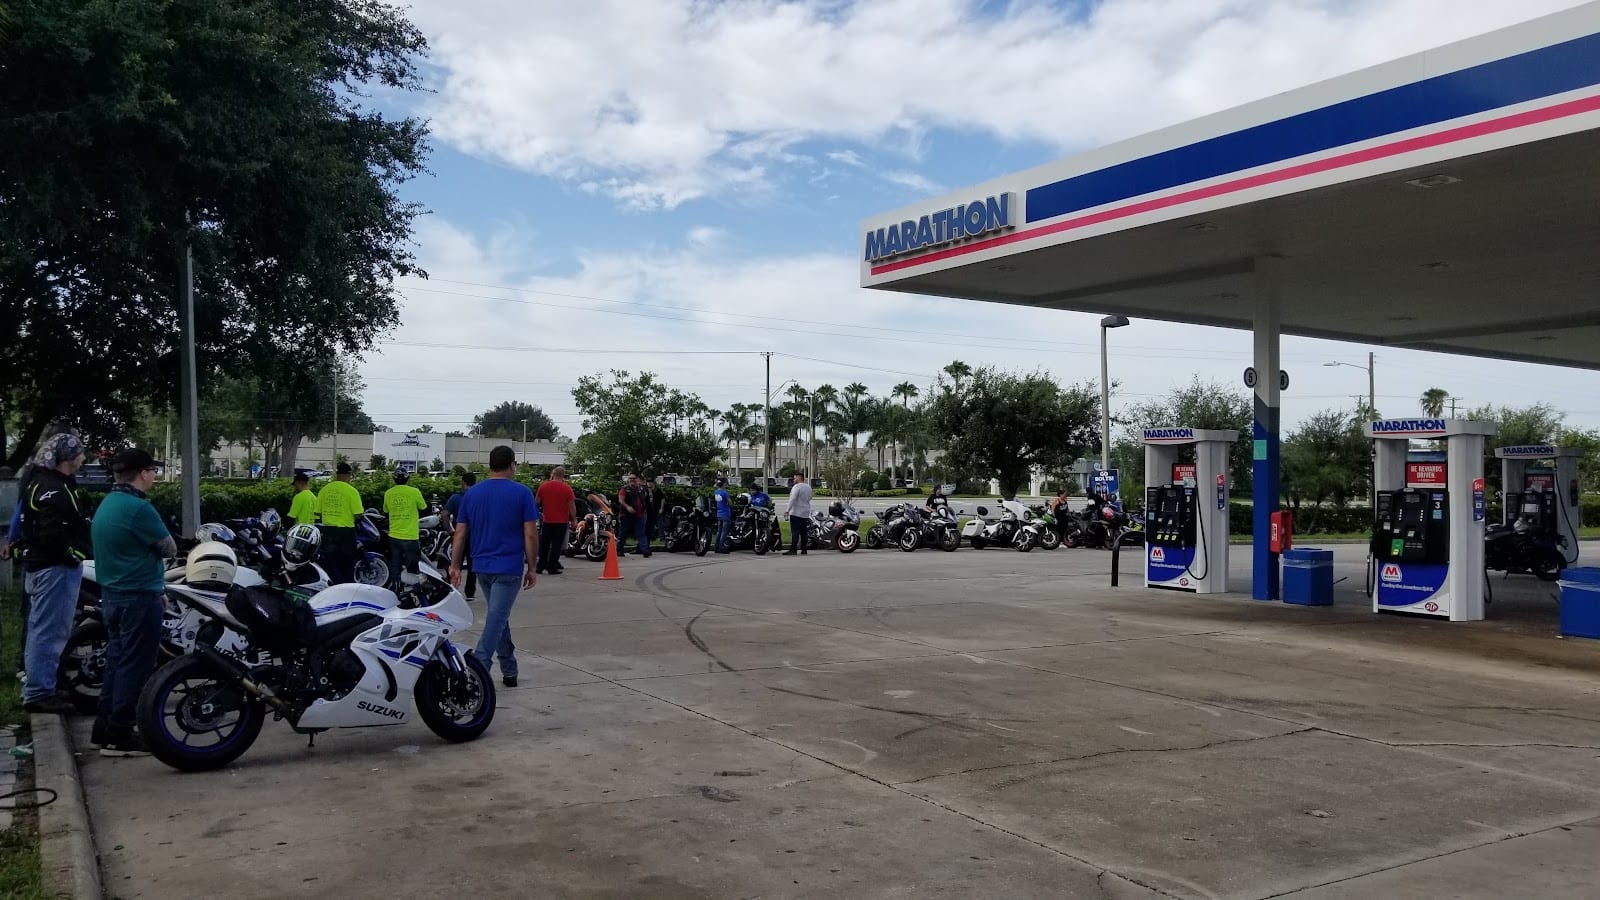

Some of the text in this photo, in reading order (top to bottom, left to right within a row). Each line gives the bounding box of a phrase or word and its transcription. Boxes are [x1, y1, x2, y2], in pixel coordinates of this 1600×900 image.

[864, 192, 1010, 262] MARATHON
[1372, 419, 1446, 431] MARATHON
[1143, 428, 1193, 438] MARATHON
[1503, 446, 1554, 454] MARATHON
[1434, 501, 1441, 509] 3
[1385, 566, 1398, 576] M
[357, 700, 405, 720] SUZUKI
